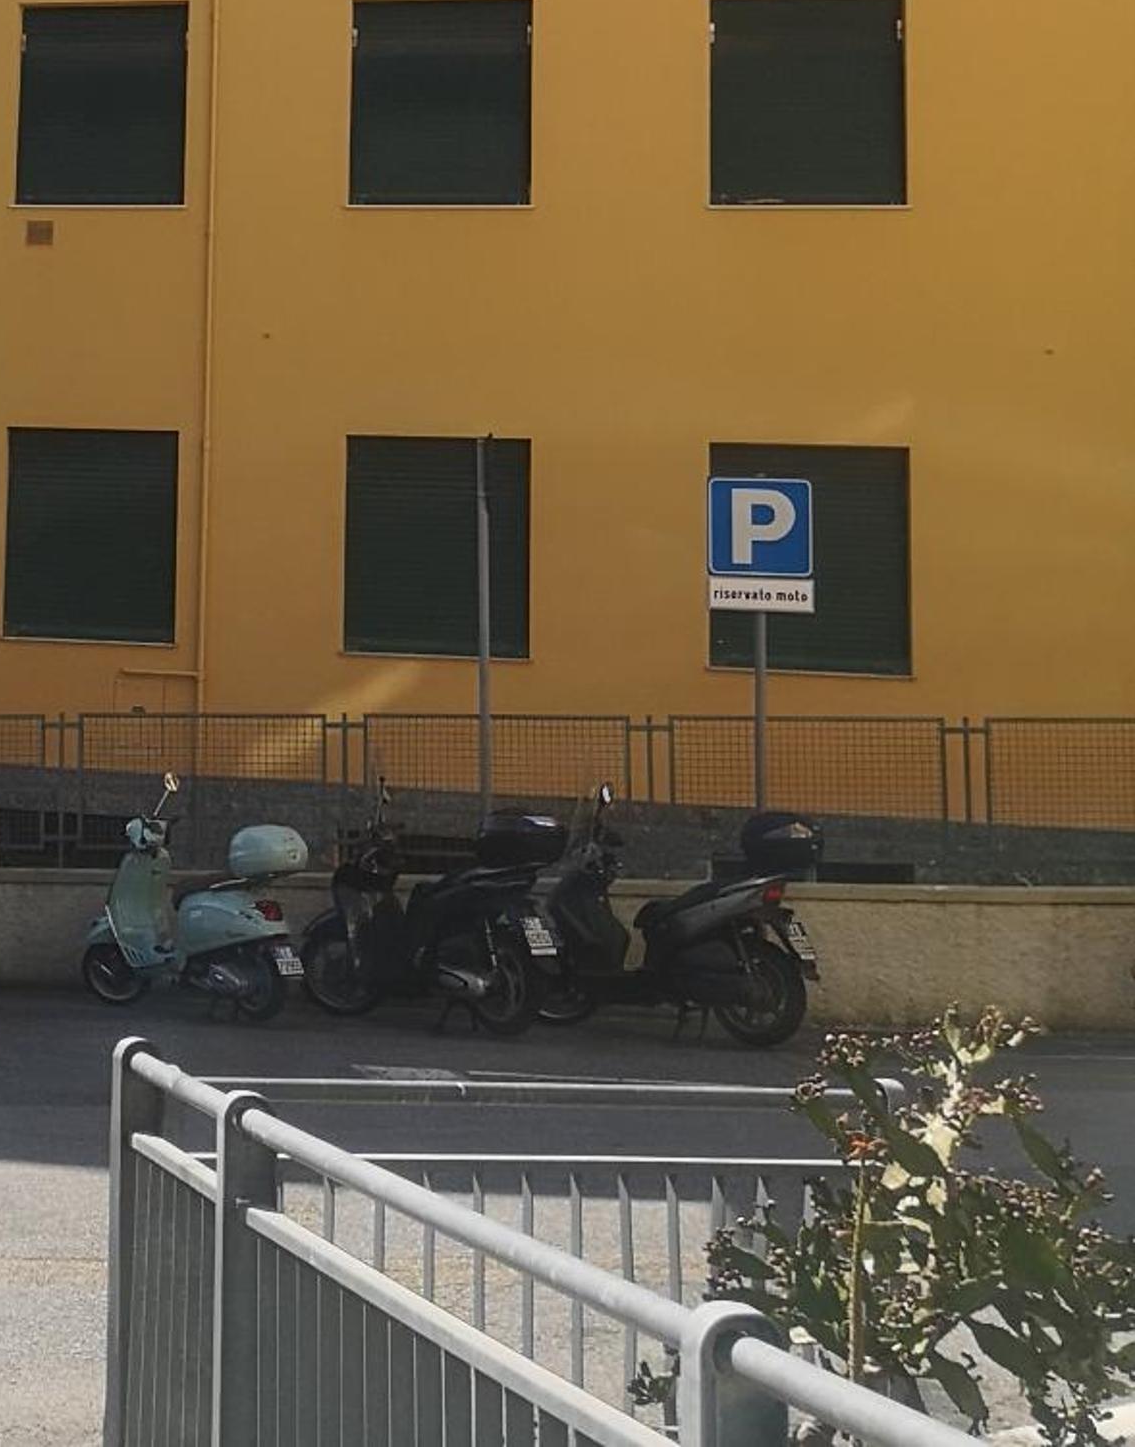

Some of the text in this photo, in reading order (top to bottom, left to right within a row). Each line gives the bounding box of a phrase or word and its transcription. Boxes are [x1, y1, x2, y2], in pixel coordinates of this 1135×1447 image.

[731, 488, 796, 564] P
[713, 586, 809, 602] riservato moto
